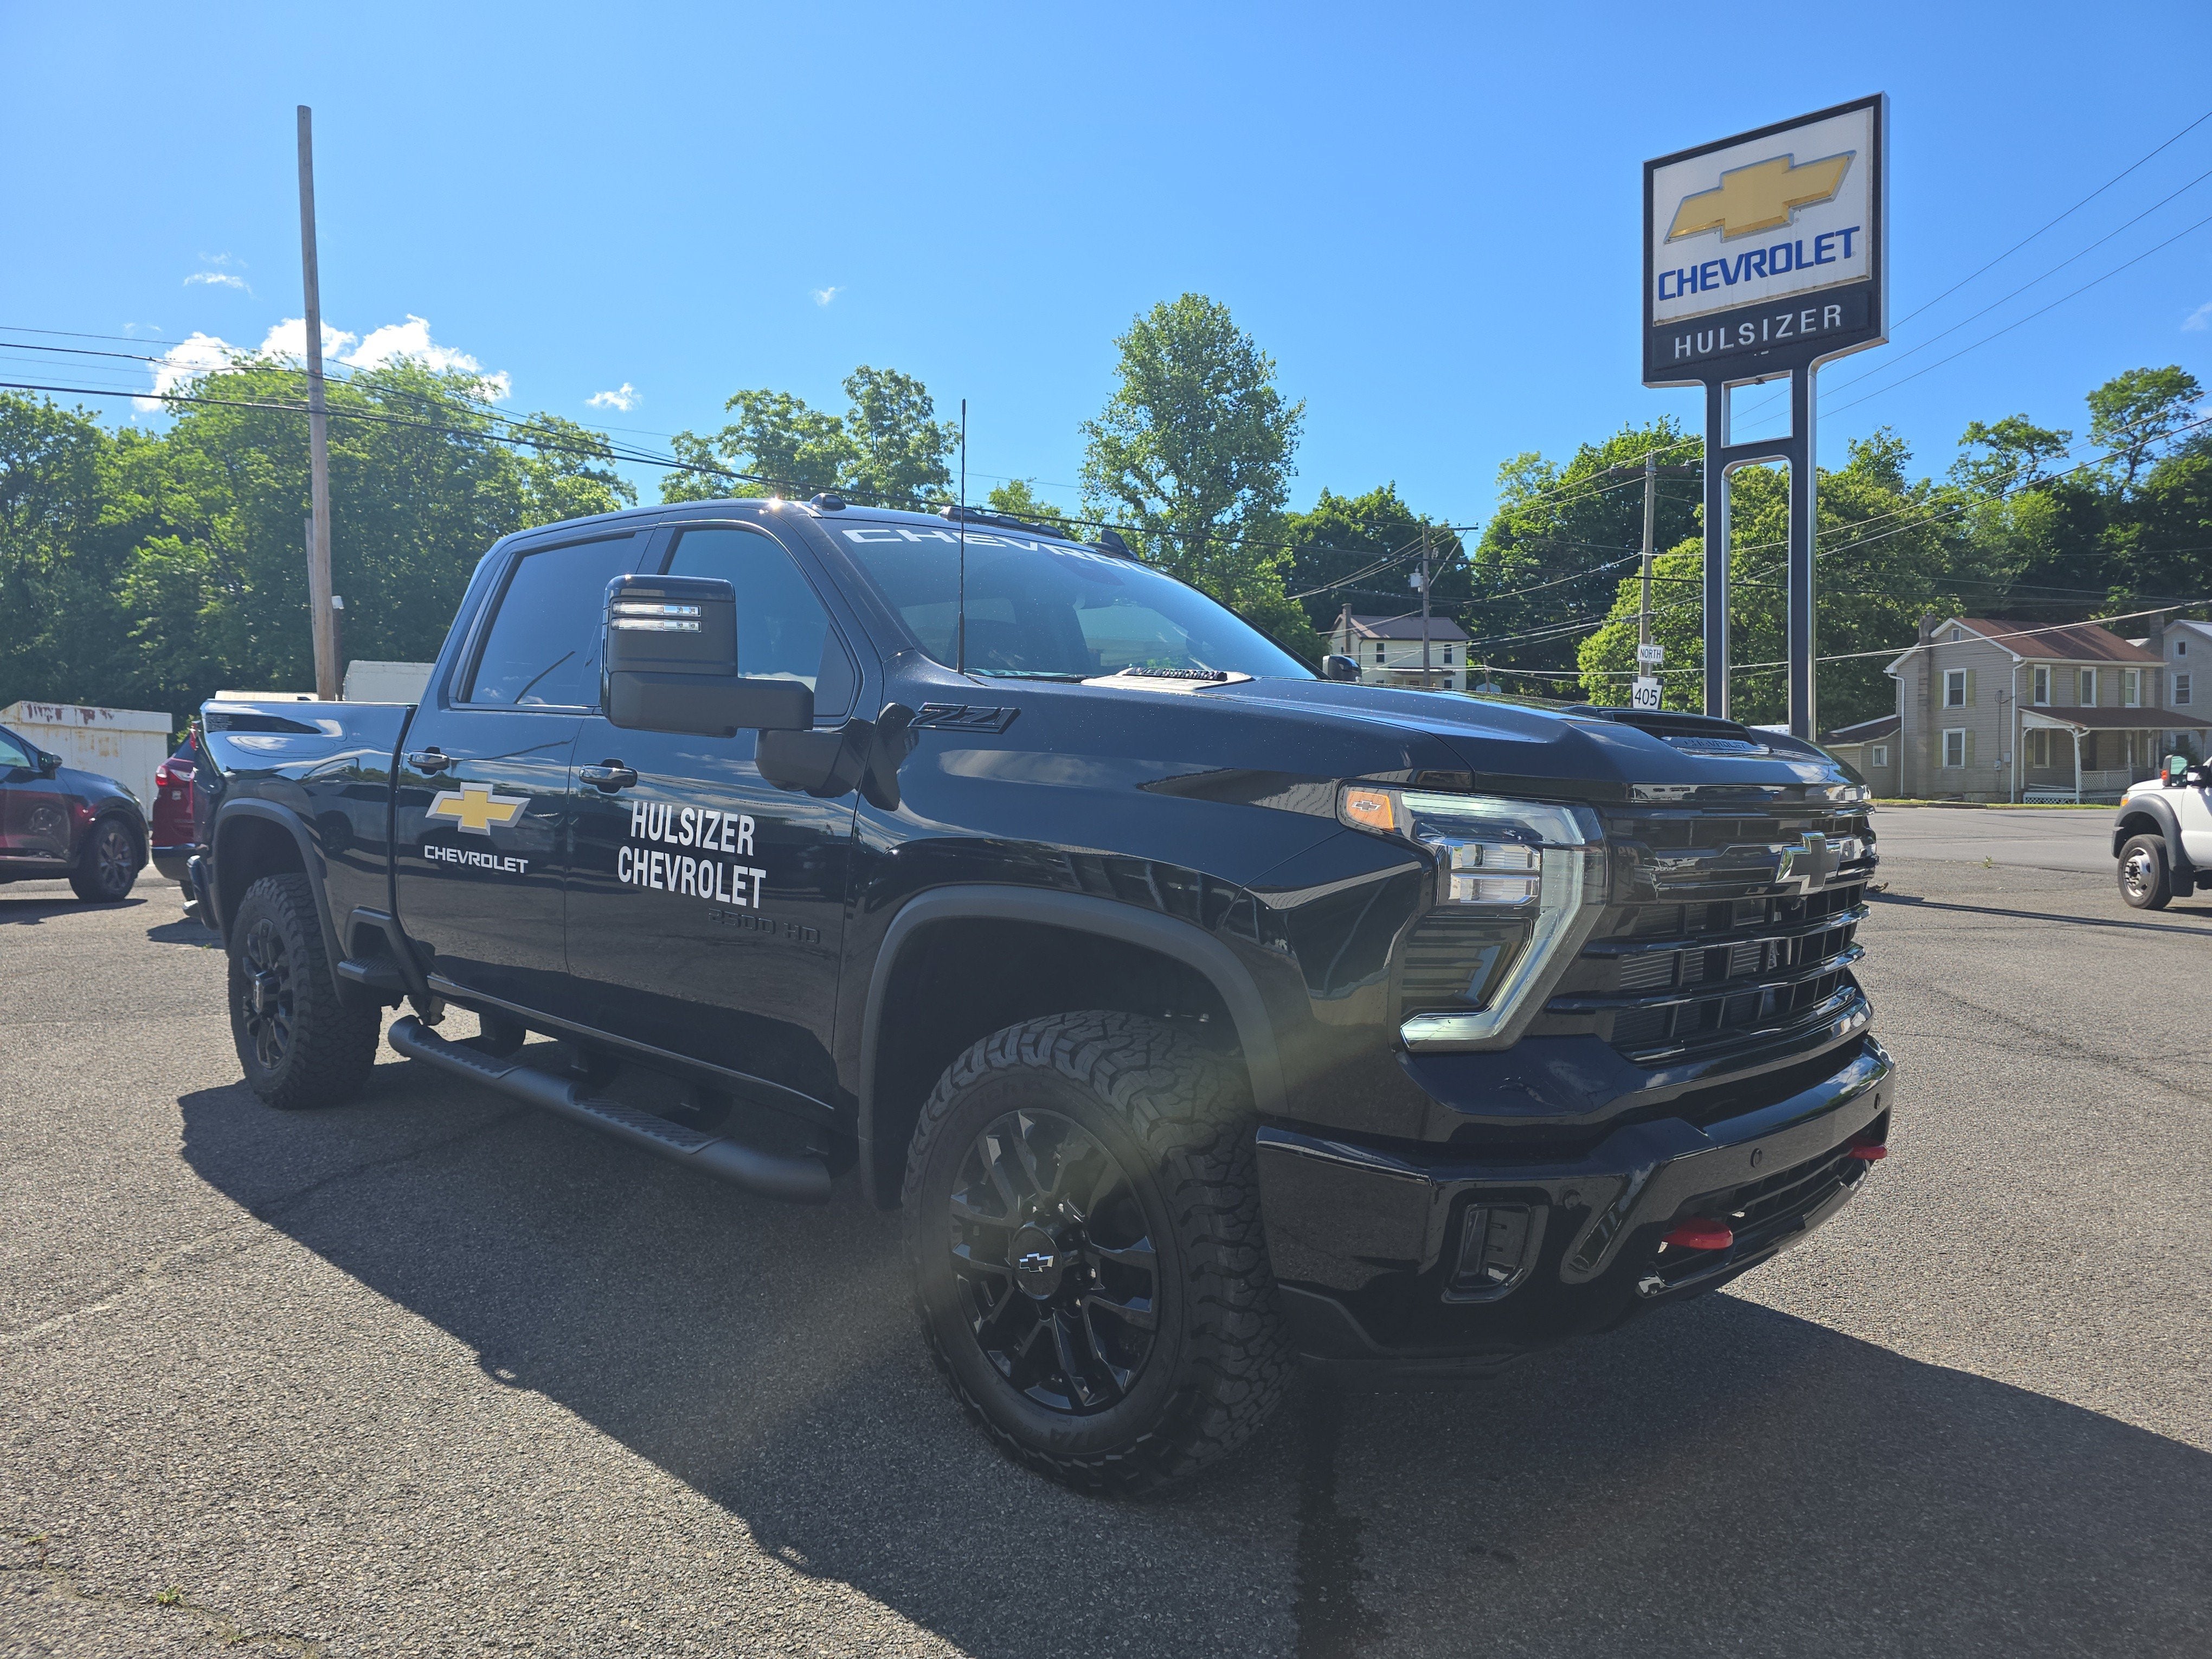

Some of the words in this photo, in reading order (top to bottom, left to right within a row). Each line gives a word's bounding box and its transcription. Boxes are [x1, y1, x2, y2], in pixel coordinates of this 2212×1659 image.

[1659, 226, 1860, 300] CHEVROLET
[1675, 305, 1841, 358] HULSIZER
[841, 529, 1176, 583] CHEVROL
[1640, 648, 1661, 659] NORTH
[1635, 688, 1657, 706] 405
[906, 702, 1021, 735] Z71
[1684, 740, 1746, 749] CHVROLET
[631, 801, 755, 856] HULSIZER
[425, 846, 529, 873] CHEVROLET
[618, 846, 766, 908] CHEVROLET
[709, 908, 776, 935] 2500
[783, 923, 820, 944] HD
